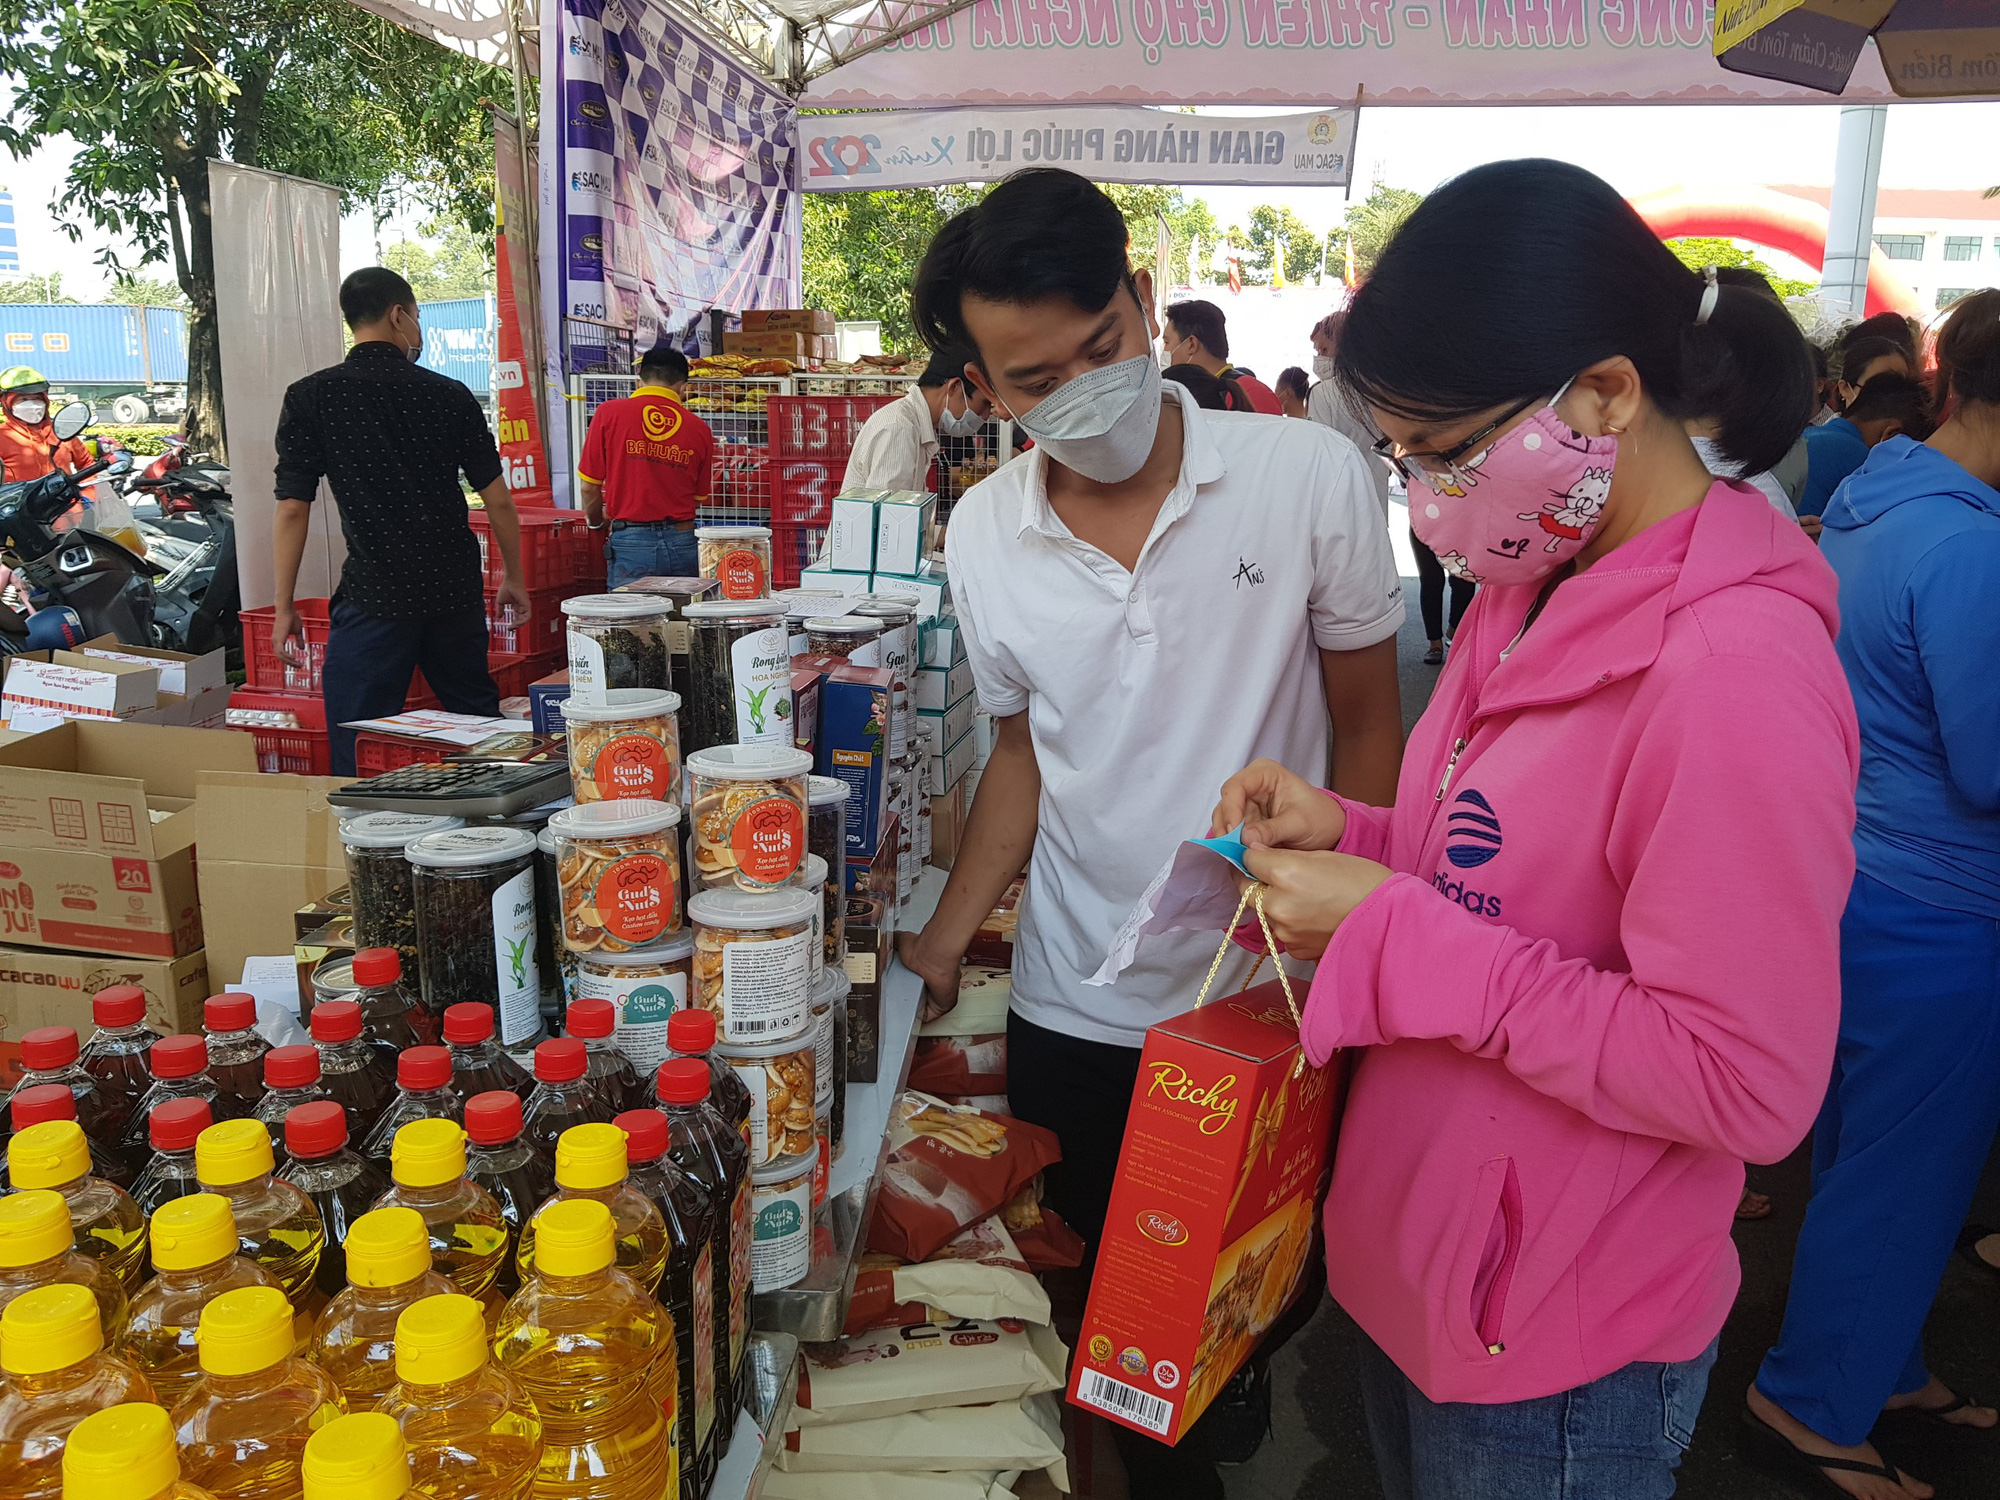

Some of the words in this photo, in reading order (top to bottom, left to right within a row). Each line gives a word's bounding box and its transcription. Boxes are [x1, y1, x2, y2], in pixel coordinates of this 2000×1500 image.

[626, 439, 646, 454] BA
[751, 655, 776, 672] Rong
[752, 673, 769, 682] HOA
[627, 738, 655, 748] NATURAL
[613, 763, 653, 776] Gud's
[614, 775, 654, 786] Nuts
[768, 803, 794, 812] NATURAL
[753, 829, 791, 842] Gud's
[846, 834, 861, 843] FDA
[753, 840, 792, 853] Nuts
[633, 858, 661, 867] NATURAL
[120, 869, 145, 884] 20
[618, 885, 660, 900] Gud's
[619, 897, 660, 912] Nuts
[634, 994, 666, 1005] Gud's
[634, 1003, 666, 1013] Nuts
[1148, 1061, 1239, 1135] Richy
[1140, 1101, 1161, 1112] LUXURY
[1162, 1108, 1198, 1125] ASSORTMENT
[1147, 1214, 1178, 1241] Richy
[906, 1339, 942, 1350] GOLD
[1095, 1341, 1107, 1351] ISO
[1123, 1355, 1145, 1369] HACCP
[1092, 1397, 1123, 1415] 938506
[1127, 1411, 1159, 1431] 170380
